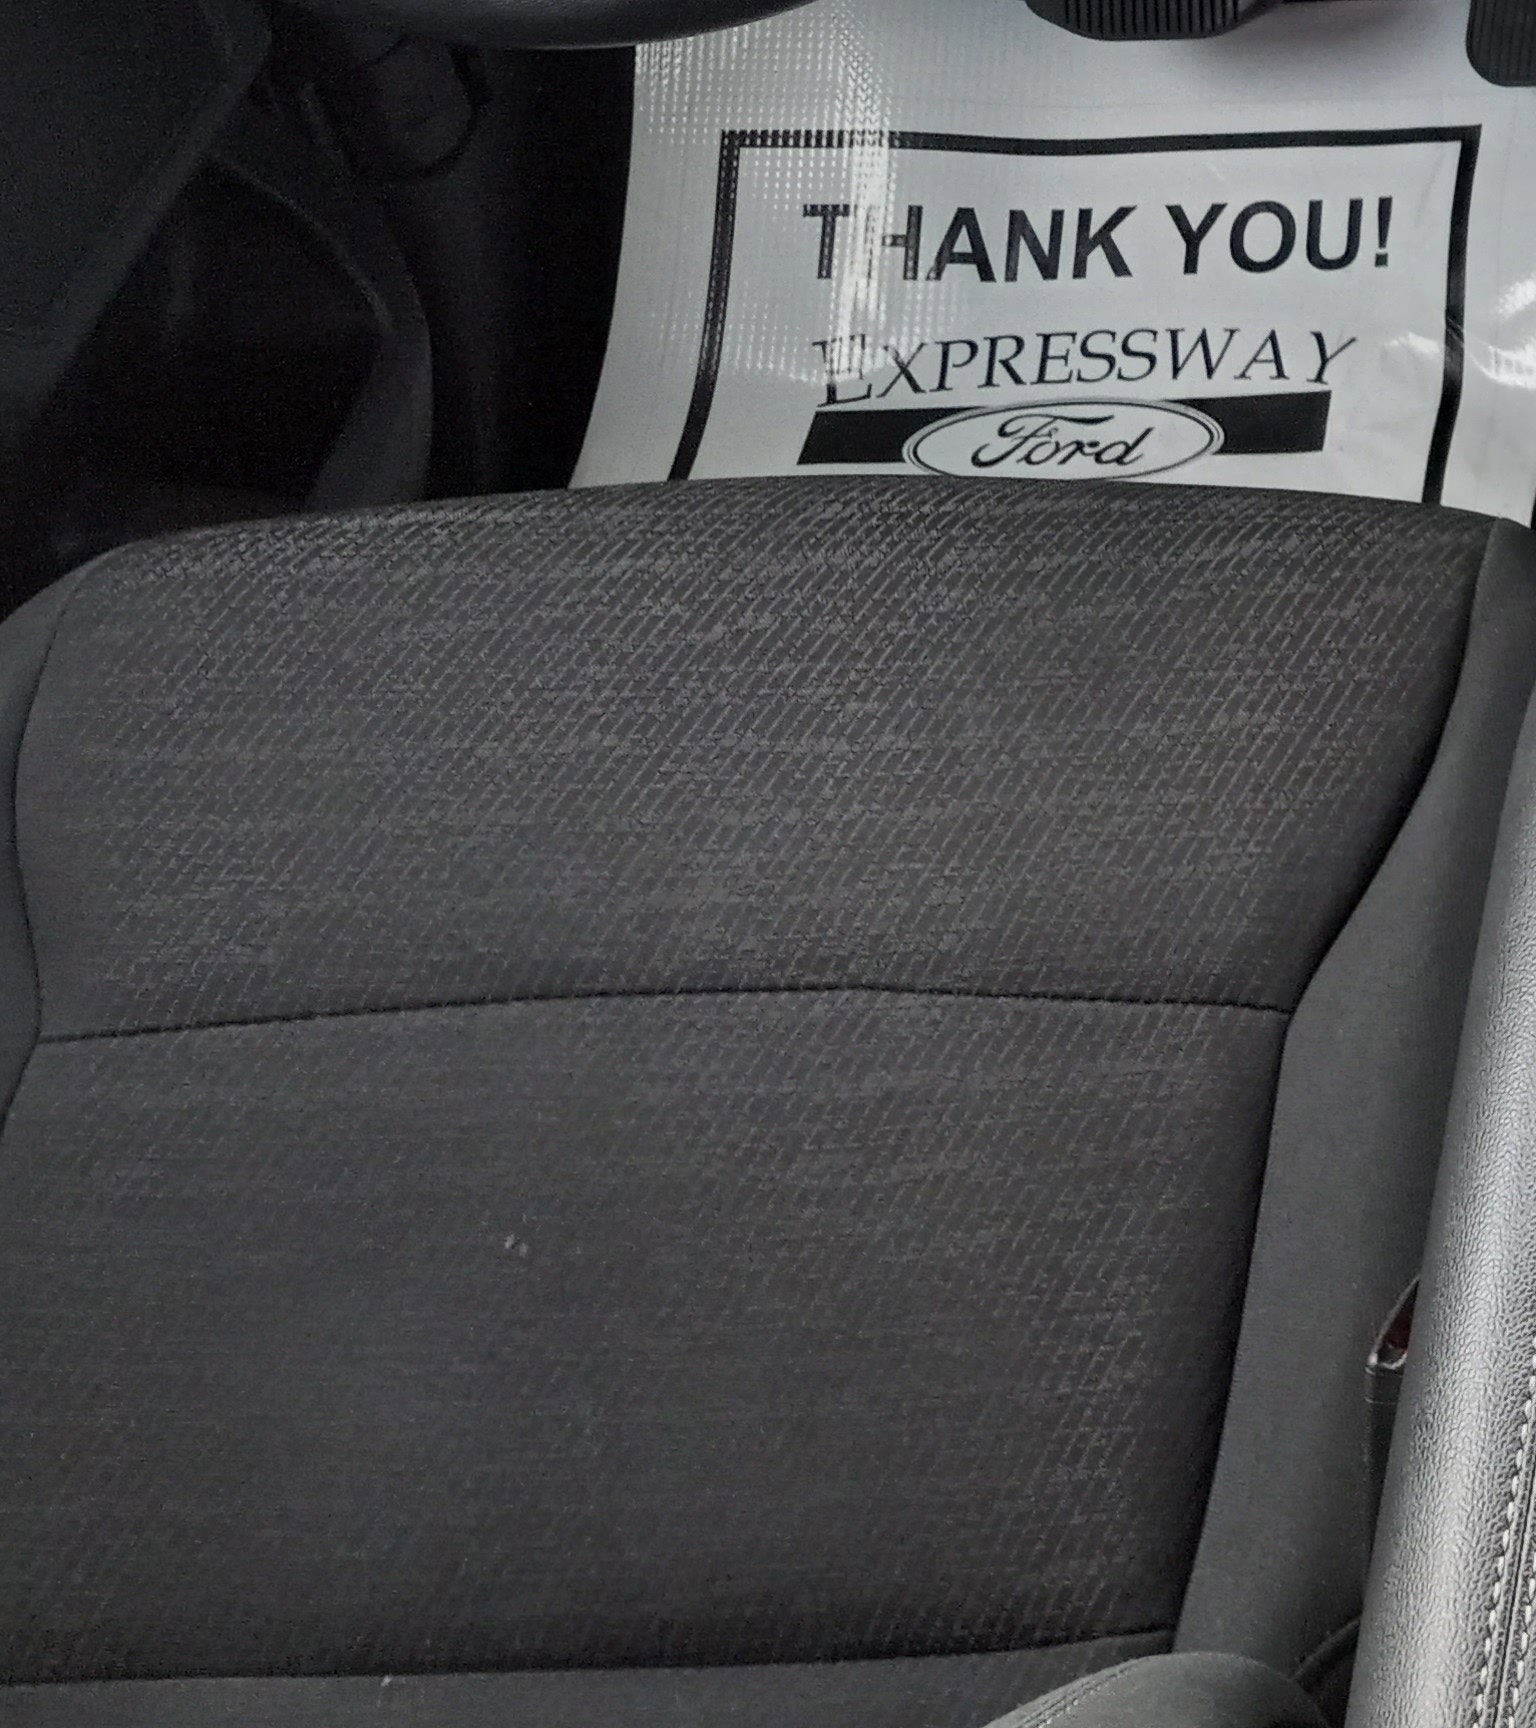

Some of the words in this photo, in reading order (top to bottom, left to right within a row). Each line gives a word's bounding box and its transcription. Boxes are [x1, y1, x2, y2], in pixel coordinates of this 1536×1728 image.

[803, 203, 1138, 283] THANK
[1165, 196, 1393, 275] YOU!
[812, 327, 1358, 407] EXPRESSWAY
[971, 413, 1155, 468] Ford
